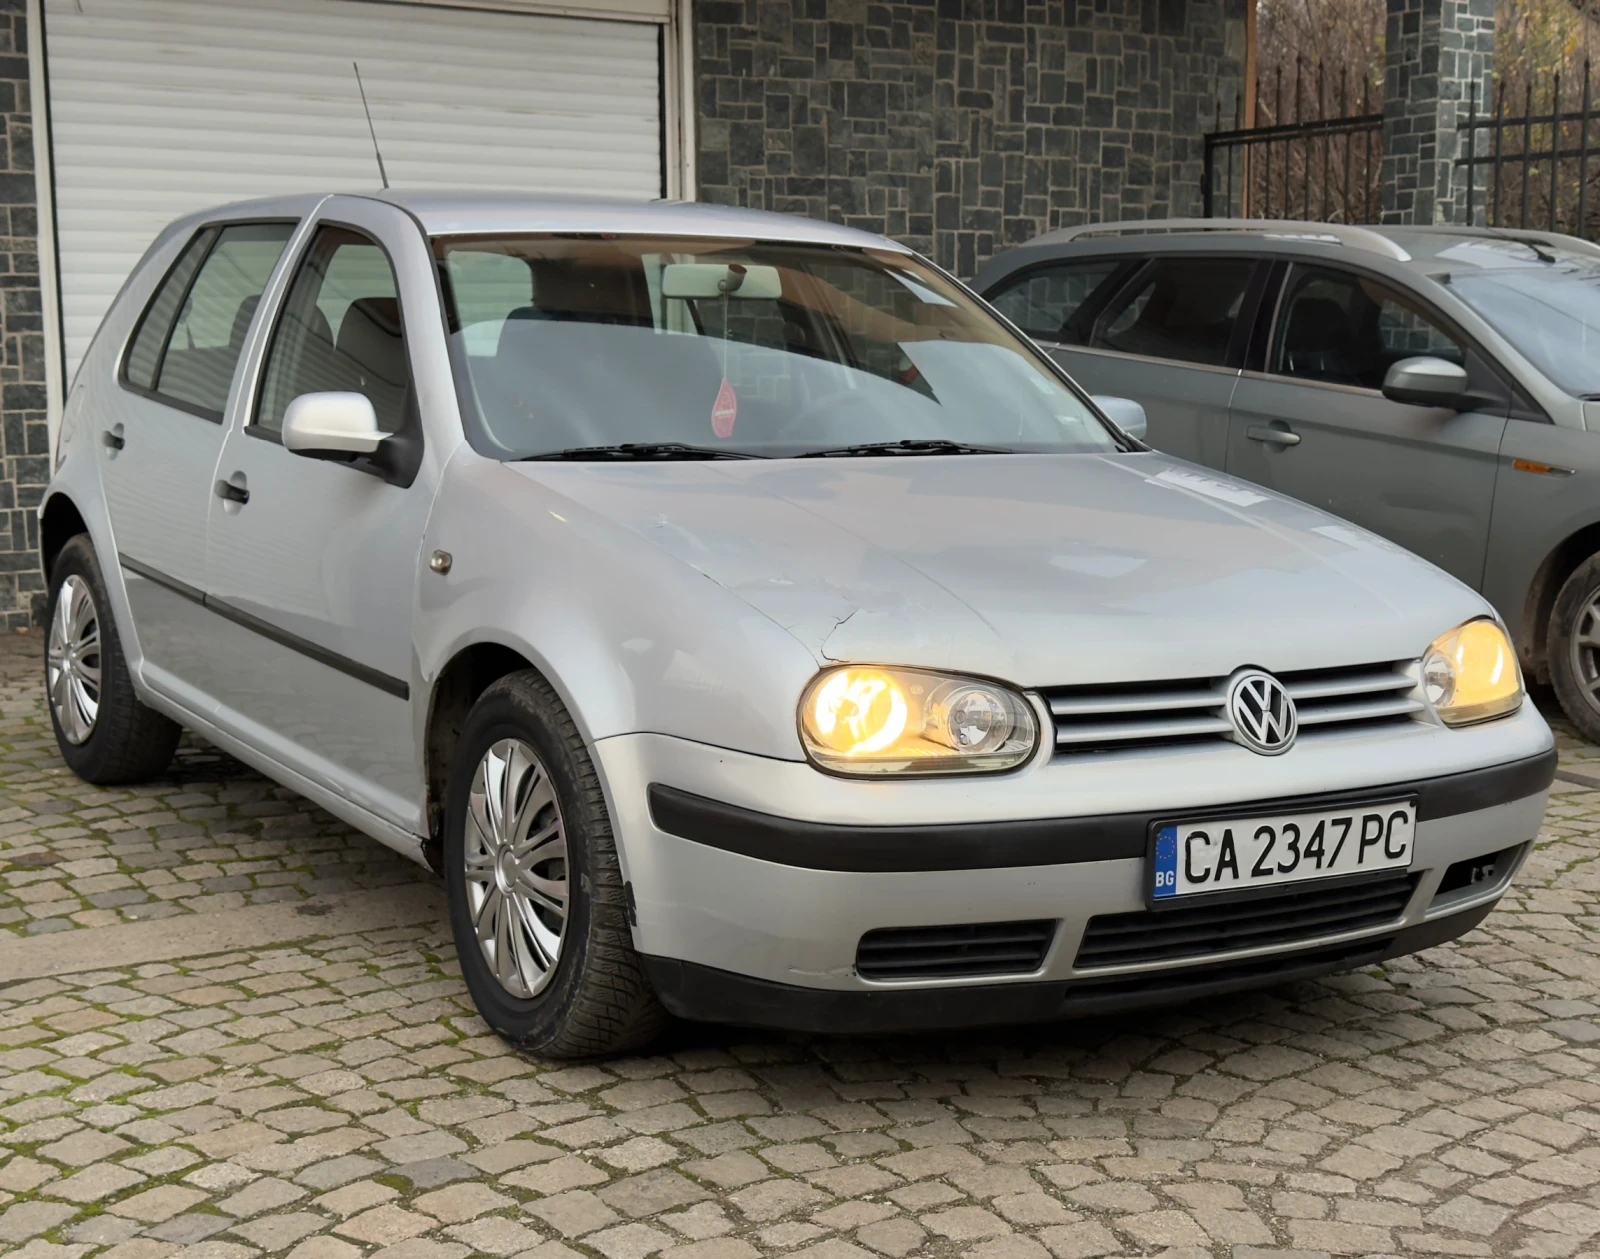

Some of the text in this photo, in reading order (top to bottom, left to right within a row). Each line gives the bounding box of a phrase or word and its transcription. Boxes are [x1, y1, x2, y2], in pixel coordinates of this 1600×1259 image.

[1231, 672, 1296, 751] VW
[1155, 870, 1175, 887] BG
[1184, 810, 1409, 884] CA 2347 PC
